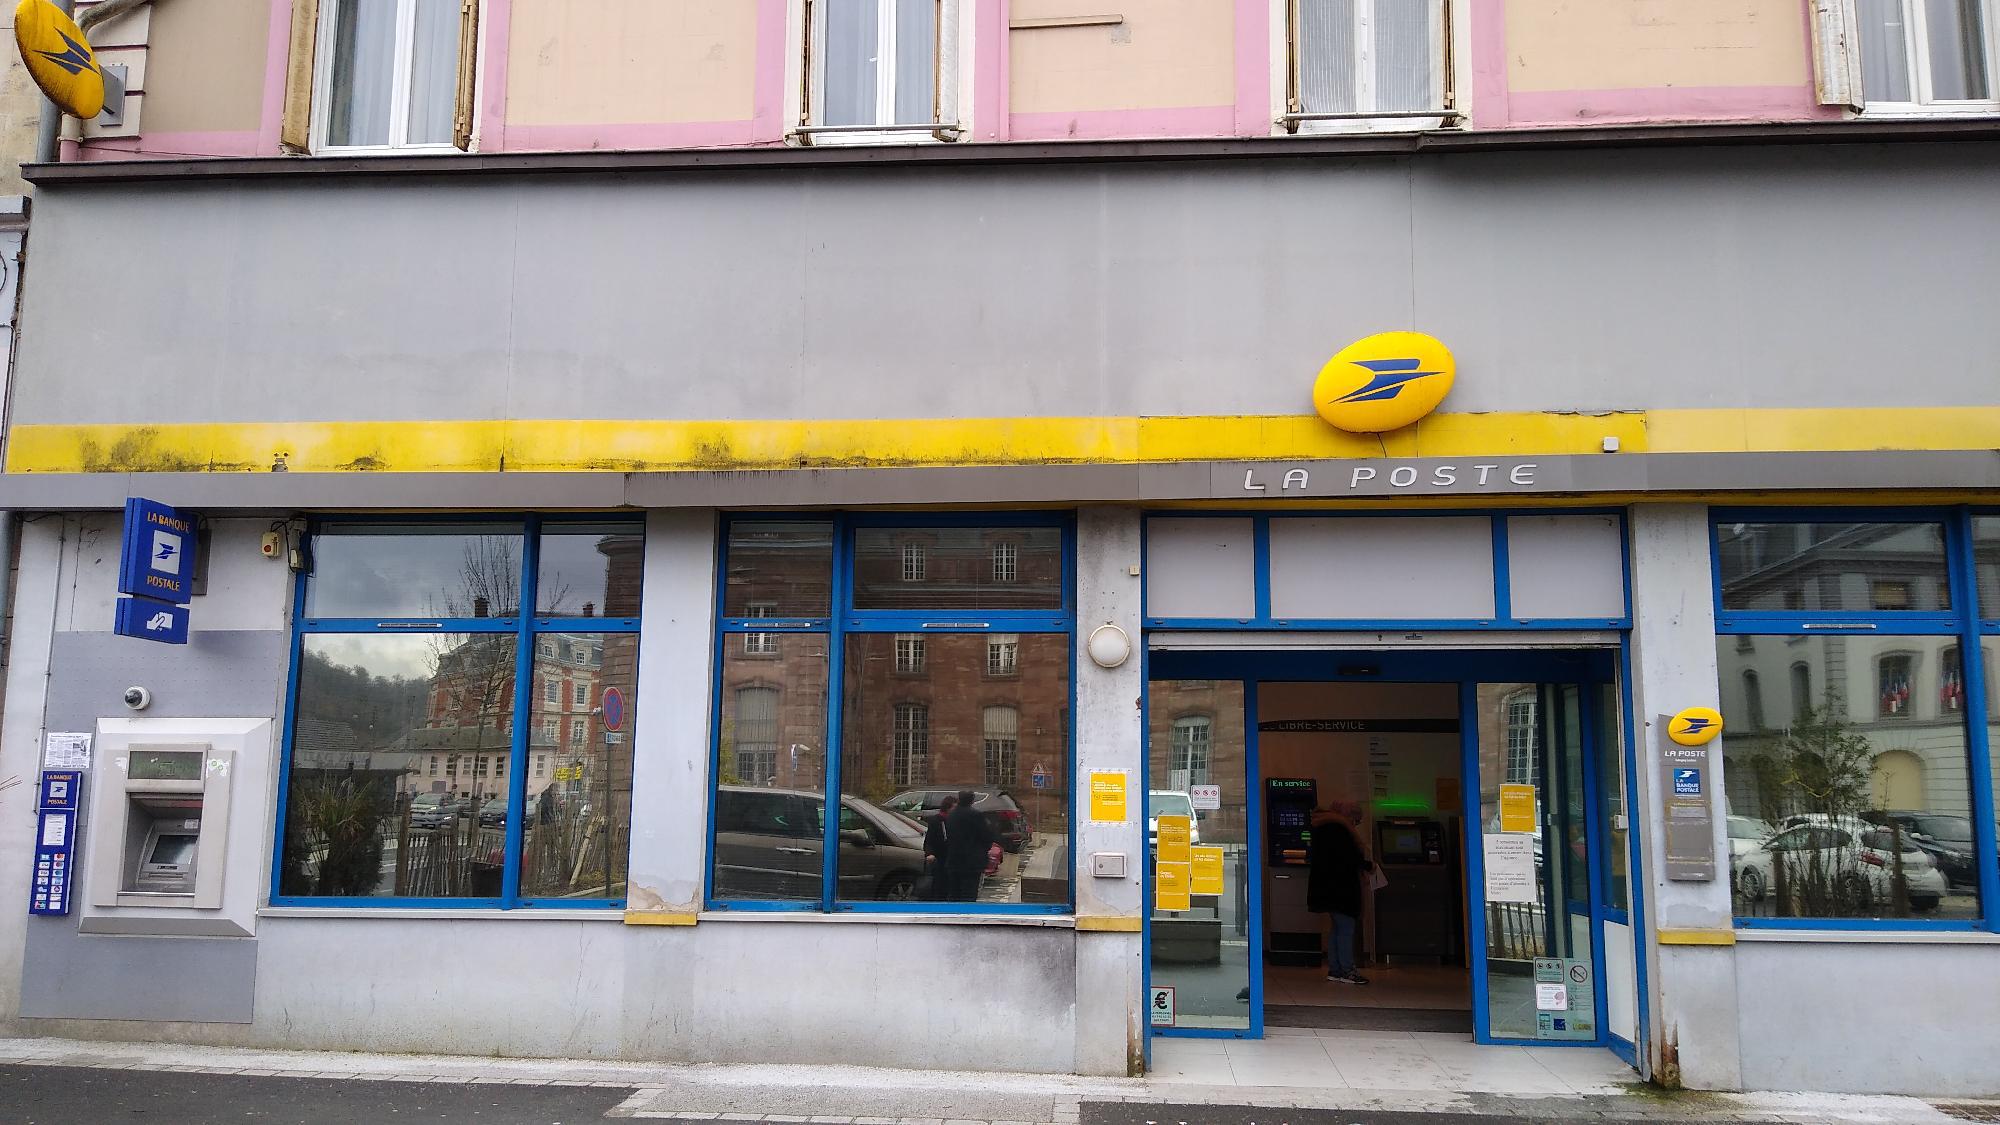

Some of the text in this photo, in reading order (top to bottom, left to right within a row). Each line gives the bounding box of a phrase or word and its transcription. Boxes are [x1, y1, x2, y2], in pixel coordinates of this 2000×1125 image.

[1244, 463, 1538, 491] LA POSTE
[147, 511, 190, 533] LA BANQUE
[147, 575, 180, 592] POSTALE
[1279, 719, 1366, 731] LIBRE-SERVICE
[1272, 779, 1283, 787] En
